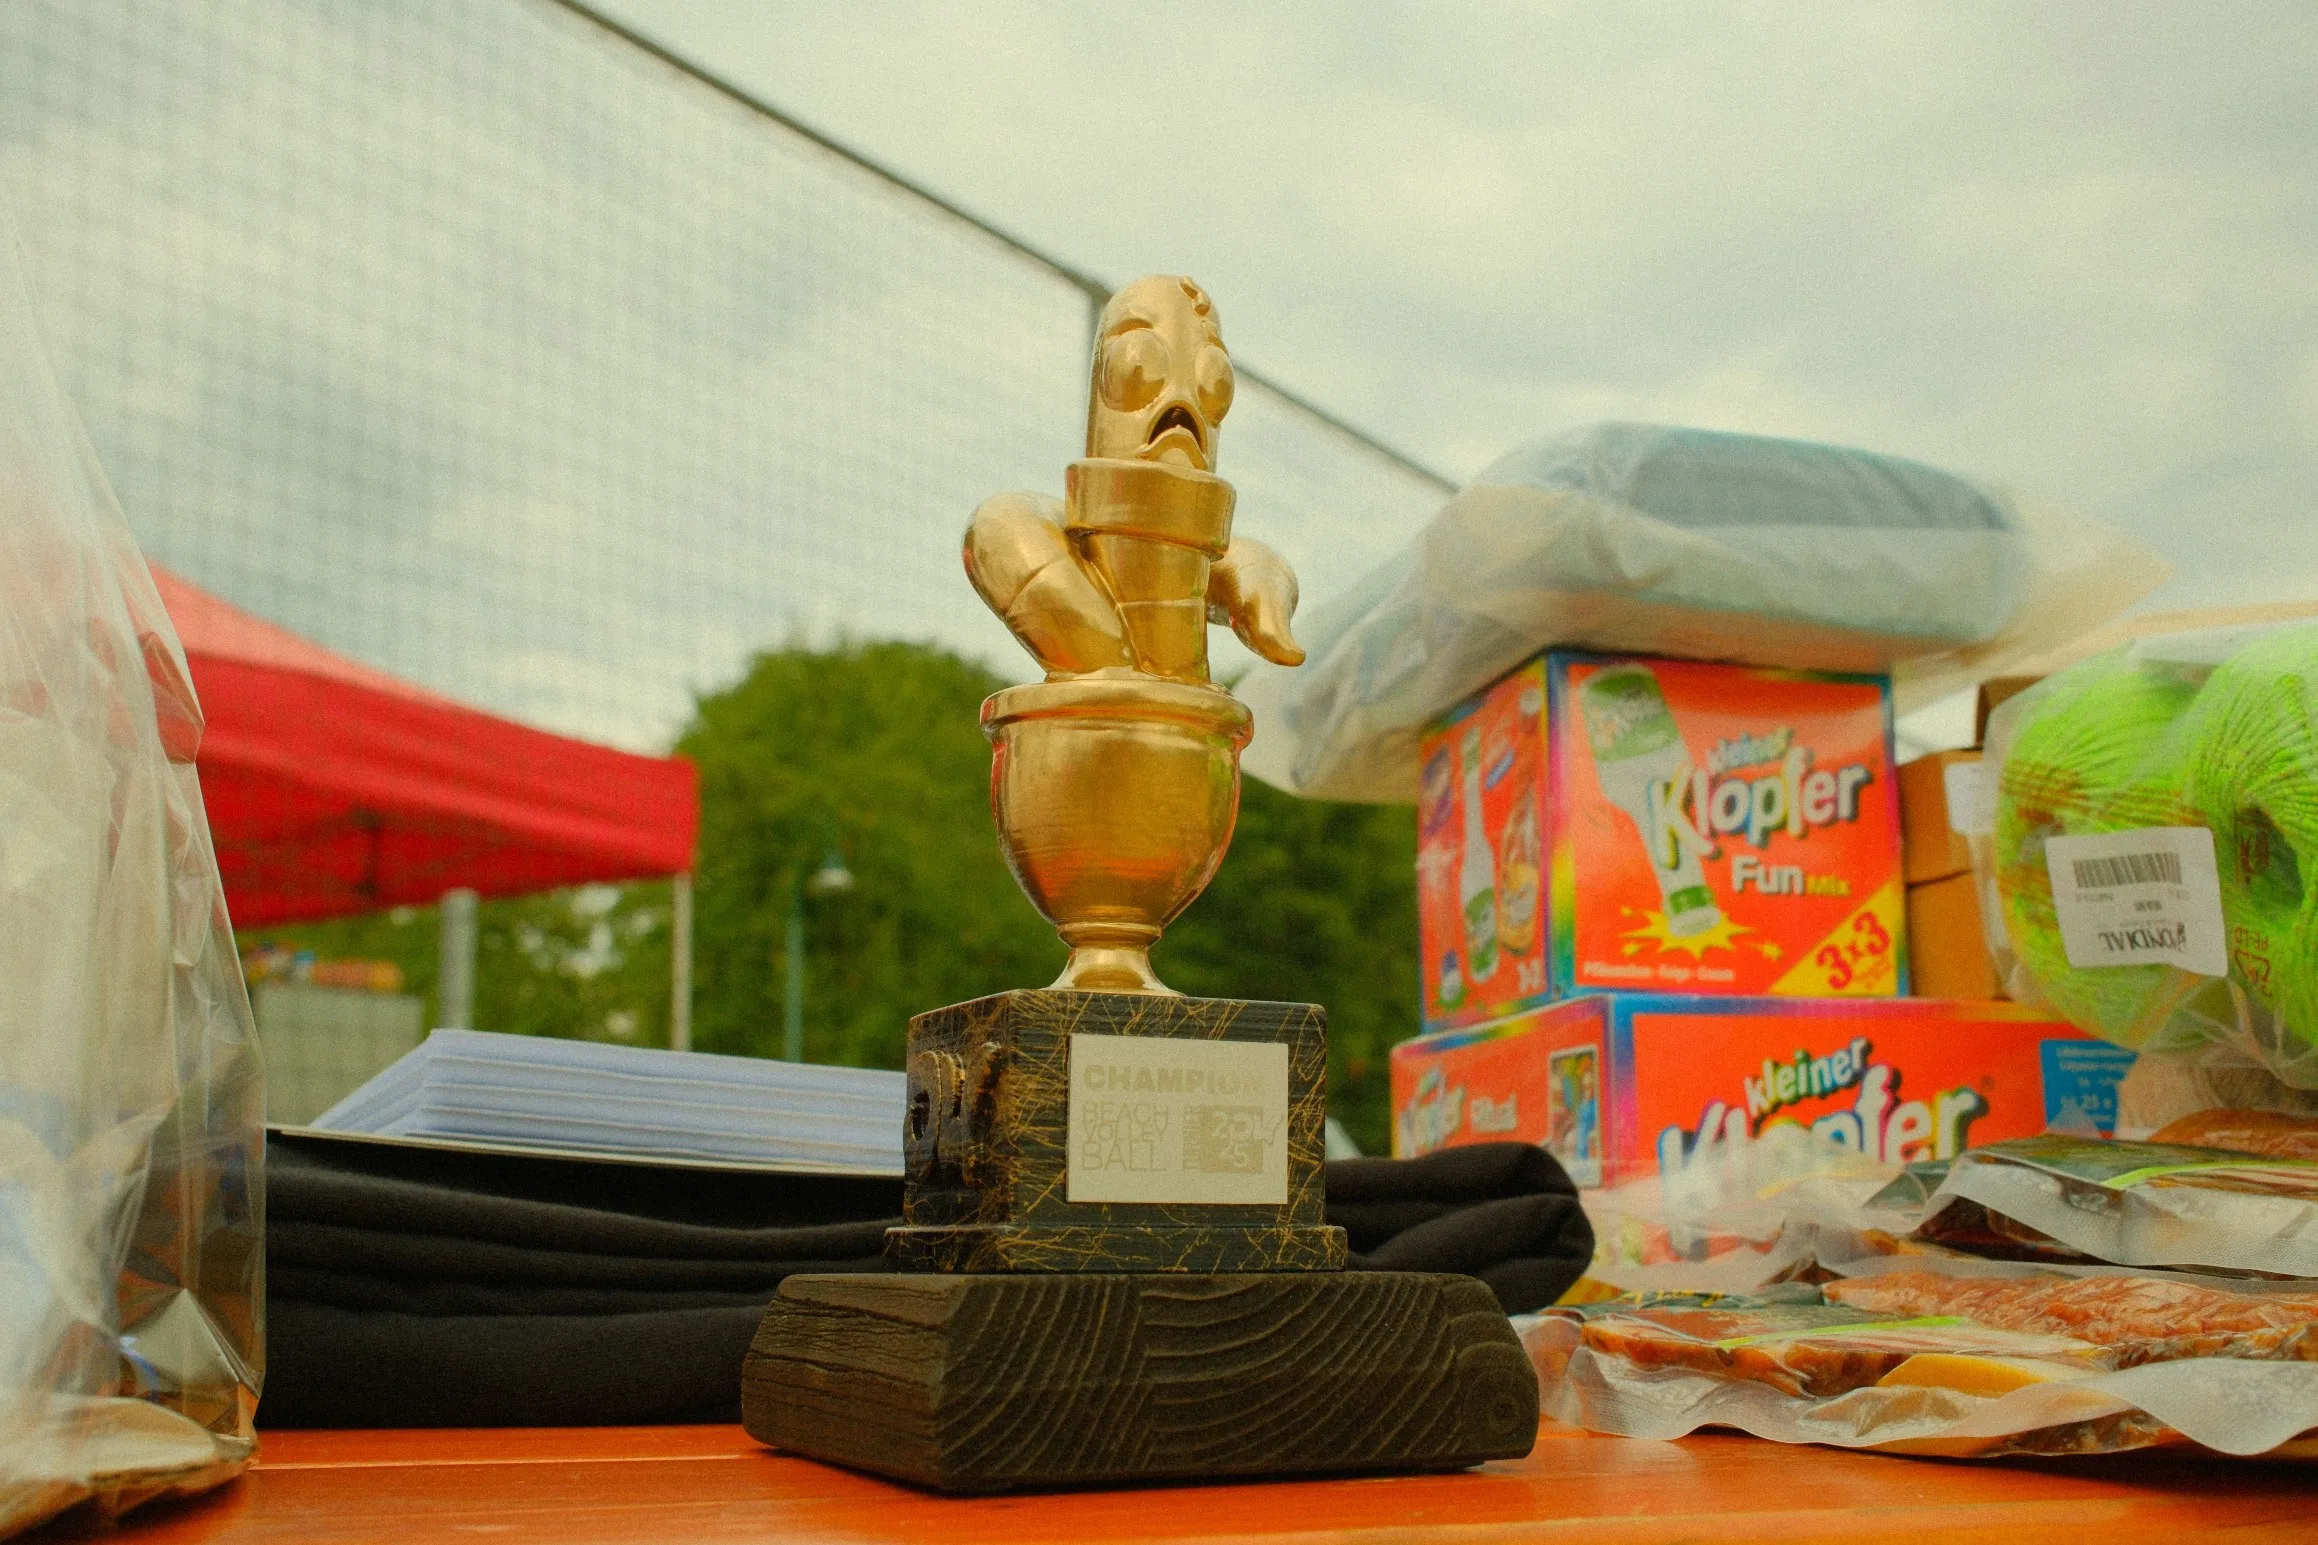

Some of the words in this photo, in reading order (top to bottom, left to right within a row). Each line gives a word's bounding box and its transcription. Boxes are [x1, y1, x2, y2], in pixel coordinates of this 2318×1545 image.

[1647, 748, 1873, 870] Klopfer
[1731, 855, 1805, 896] Fun
[1816, 911, 1890, 991] 3x3
[1743, 1036, 1874, 1121] kleiner
[1082, 1100, 1169, 1125] BEACH
[1082, 1121, 1169, 1144] VOLLEY
[1082, 1140, 1168, 1173] BALL
